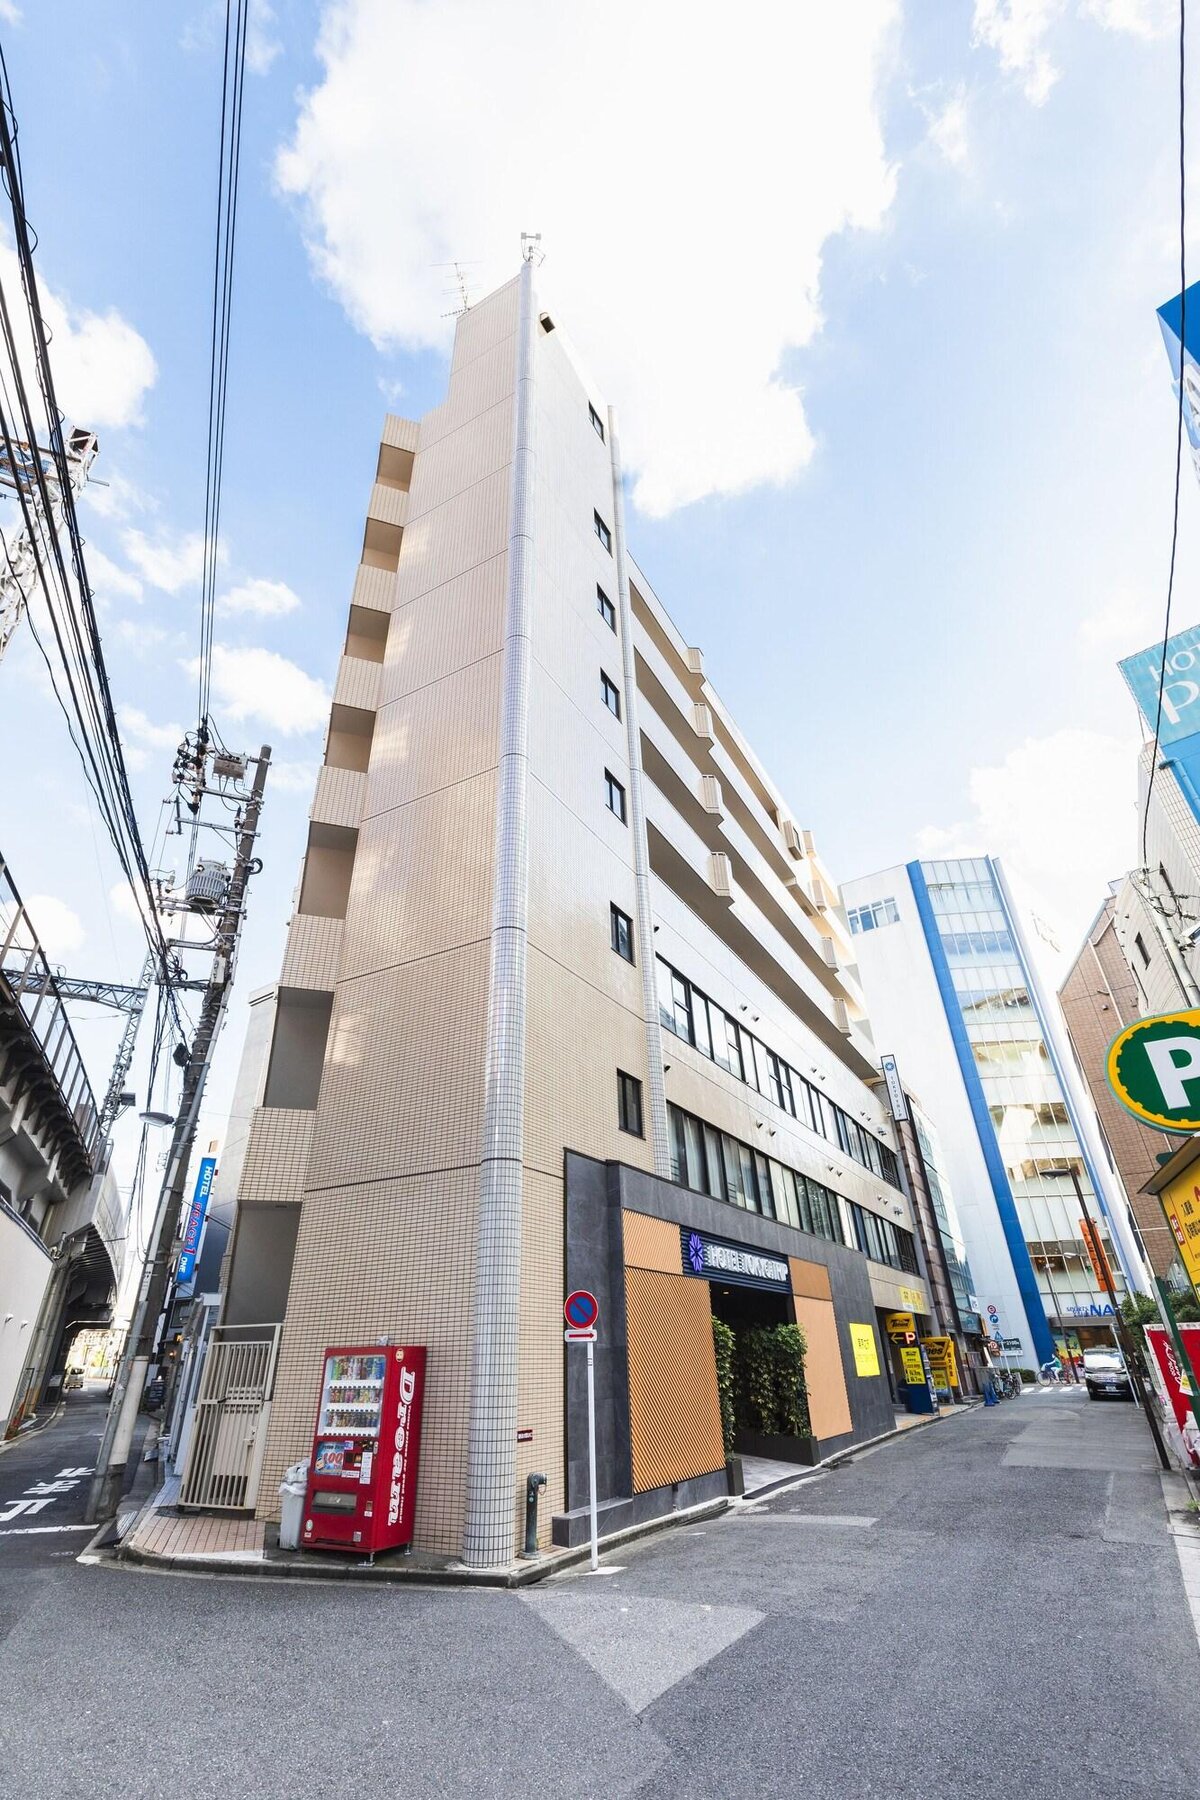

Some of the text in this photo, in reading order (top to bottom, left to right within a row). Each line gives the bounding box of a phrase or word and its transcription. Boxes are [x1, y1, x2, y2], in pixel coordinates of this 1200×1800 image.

[1143, 1036, 1200, 1110] P
[199, 1166, 214, 1198] HOTEL
[186, 1202, 202, 1247] PEACE
[178, 1256, 188, 1274] ONE
[706, 1245, 739, 1273] HOTEL
[1090, 1303, 1118, 1317] NA
[905, 1332, 916, 1345] P
[387, 1366, 416, 1527] Dream
